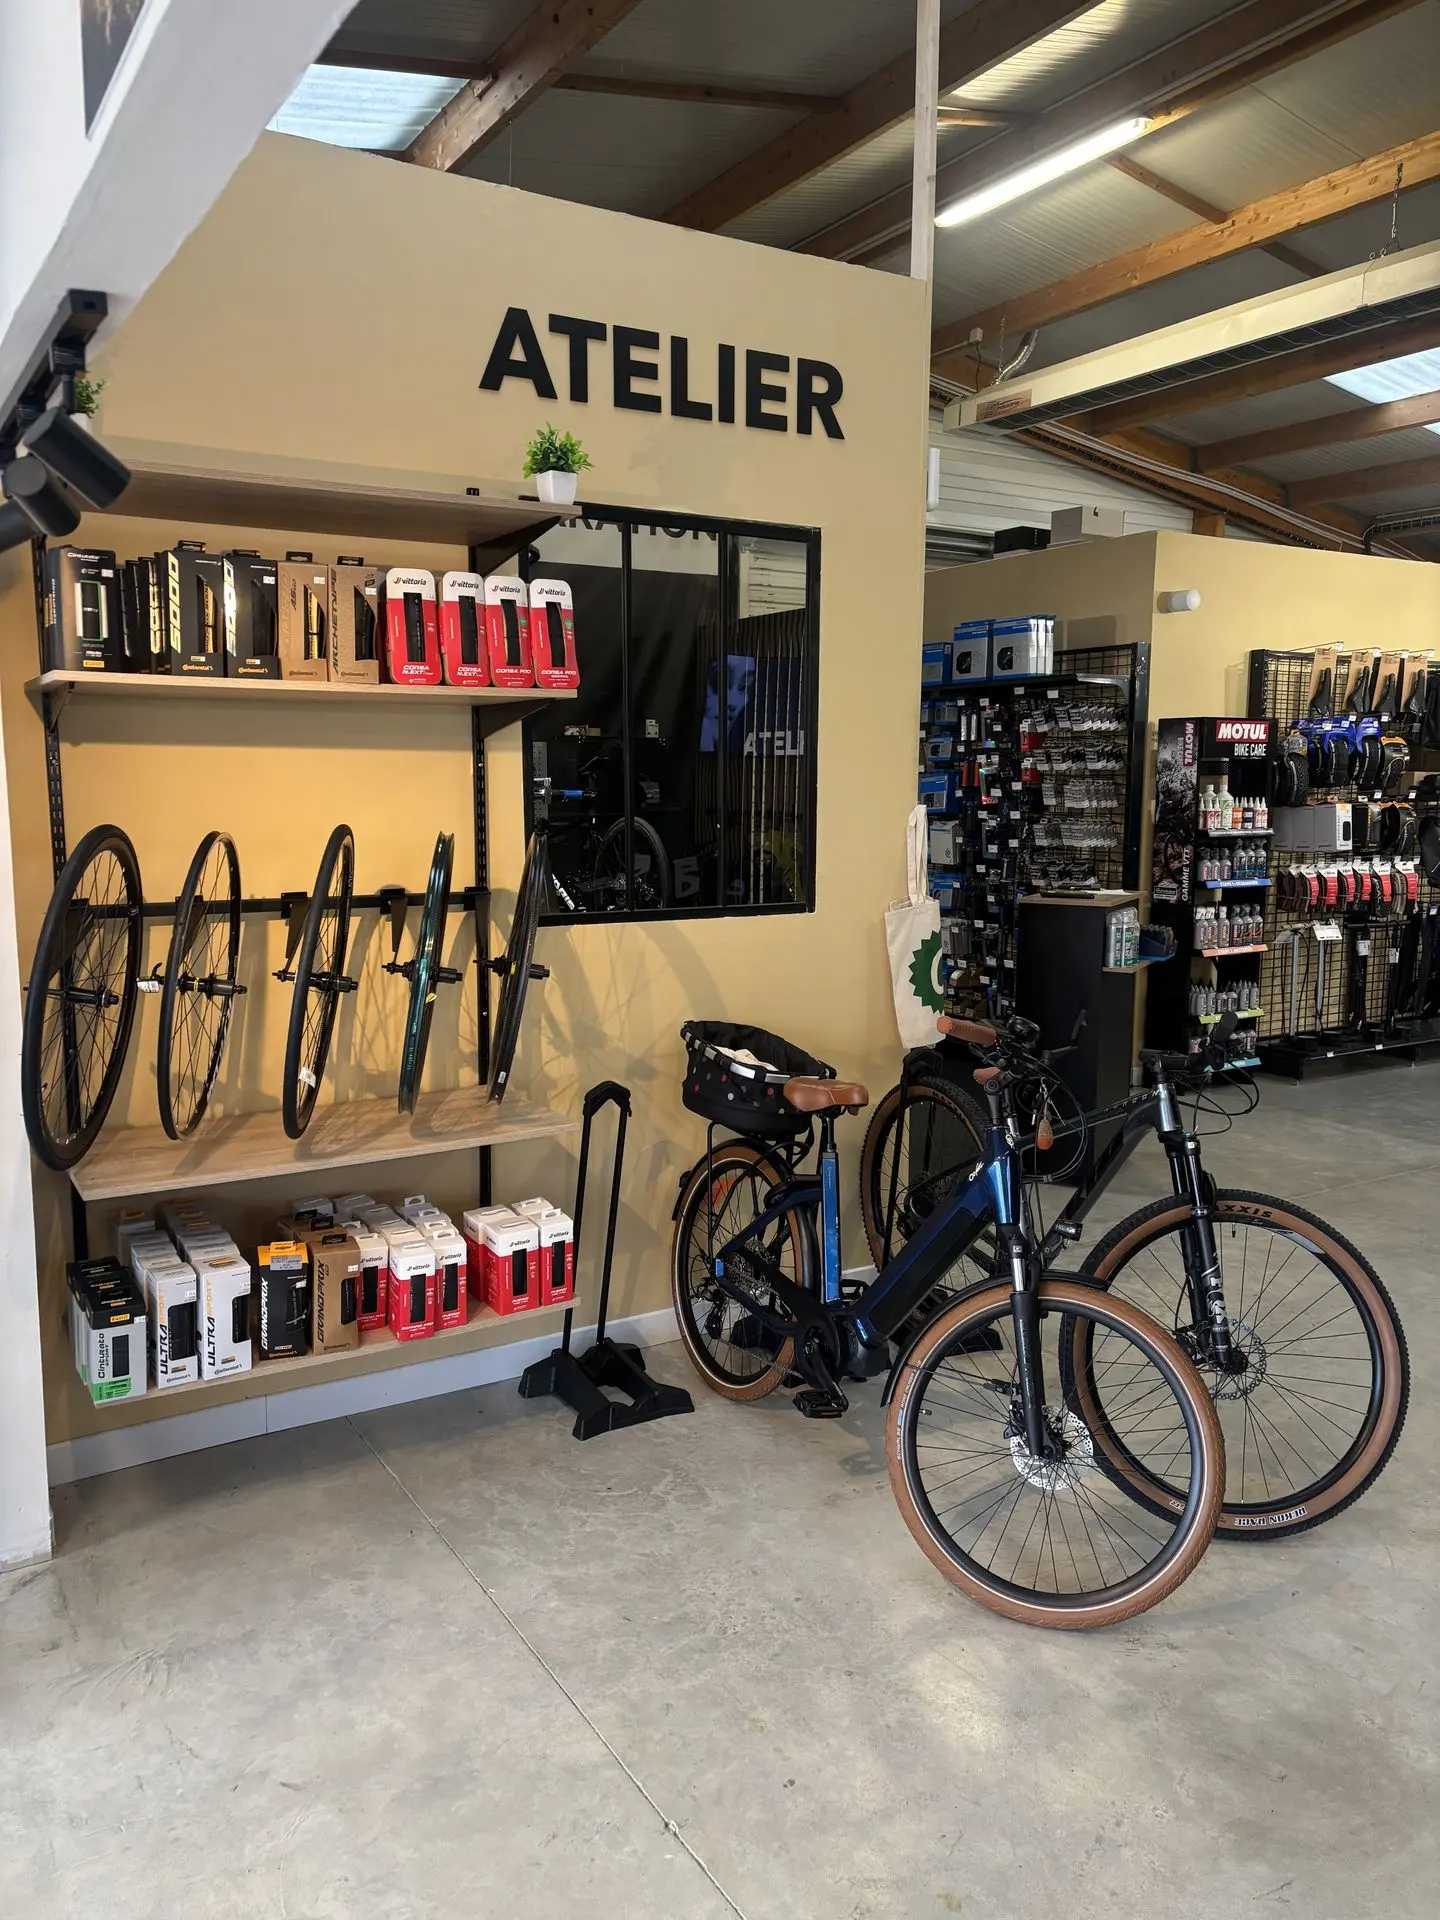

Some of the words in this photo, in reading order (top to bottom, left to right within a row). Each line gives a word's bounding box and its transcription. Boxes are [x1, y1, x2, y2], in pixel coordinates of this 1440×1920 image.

[479, 306, 845, 440] ATELIER
[402, 577, 427, 586] vittoria
[457, 581, 480, 589] vittoria
[500, 585, 521, 594] vittoria
[545, 588, 566, 597] vittoria
[168, 552, 181, 654] 5000
[330, 567, 339, 675] ARCHETYPE
[1217, 723, 1267, 740] MOTUL
[1184, 722, 1194, 765] MOTUL
[1234, 743, 1250, 757] BIKE
[1250, 743, 1267, 757] CARE
[1183, 848, 1191, 866] VTT
[1181, 867, 1190, 901] GAMME
[159, 1324, 168, 1375] ULTRA
[206, 1316, 216, 1367] ULTRA
[1234, 1517, 1267, 1527] RACE
[1268, 1506, 1308, 1525] REKON
